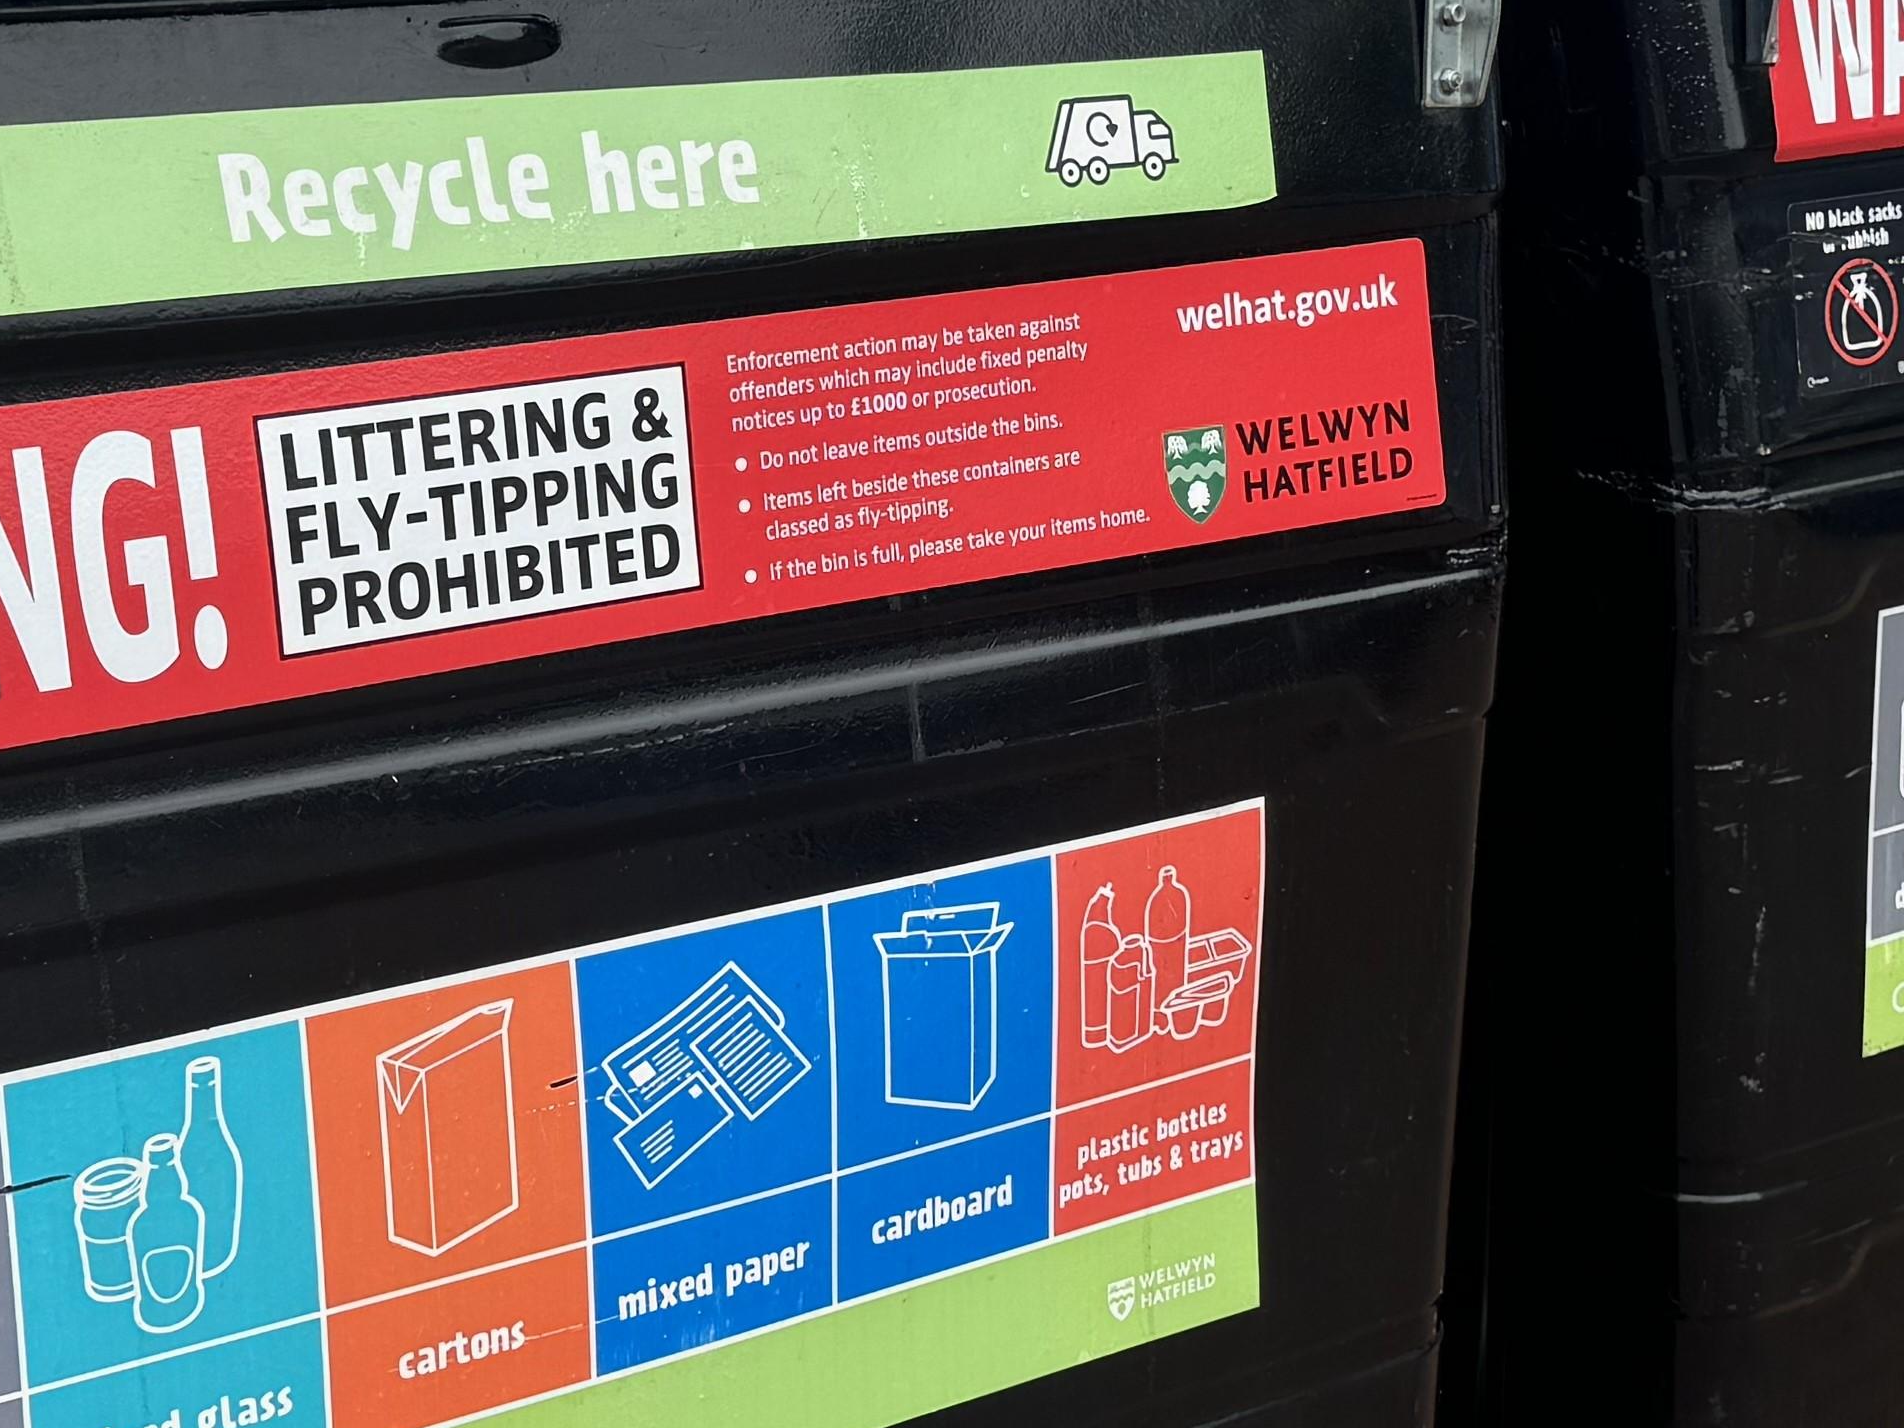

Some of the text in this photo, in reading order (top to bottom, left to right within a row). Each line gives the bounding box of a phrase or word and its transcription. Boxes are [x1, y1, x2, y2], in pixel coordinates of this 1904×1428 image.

[220, 131, 760, 250] Recycle here
[1805, 201, 1903, 232] NO black sacks
[1177, 274, 1398, 333] welhat.gov.uk
[727, 313, 1081, 374] Enforcement action may be taken against
[730, 340, 1088, 403] offenders which may include fixed penalty
[732, 377, 1037, 432] notices up to £1000 or prosecution.
[1236, 400, 1410, 456] WELWYN
[280, 388, 673, 492] LITTERING &
[760, 413, 1063, 470] Do not leave items outside the bins.
[764, 451, 1081, 511] Items left beside these containers are
[1244, 448, 1413, 503] HATFIELD
[286, 453, 679, 565] FLY-TIPPING
[766, 497, 954, 541] classed as fly-tipping.
[770, 509, 1151, 581] If the bin is full, please take your items home.
[298, 524, 681, 637] PROHIBITED
[1078, 1103, 1227, 1171] plastic bottles
[1060, 1131, 1244, 1209] pots, tubs & trays
[872, 1175, 1013, 1245] cardboard
[619, 1242, 810, 1321] mixed paper
[1139, 1253, 1216, 1290] WELWYN
[1141, 1273, 1216, 1309] HATFIELD
[399, 1321, 526, 1378] cartons
